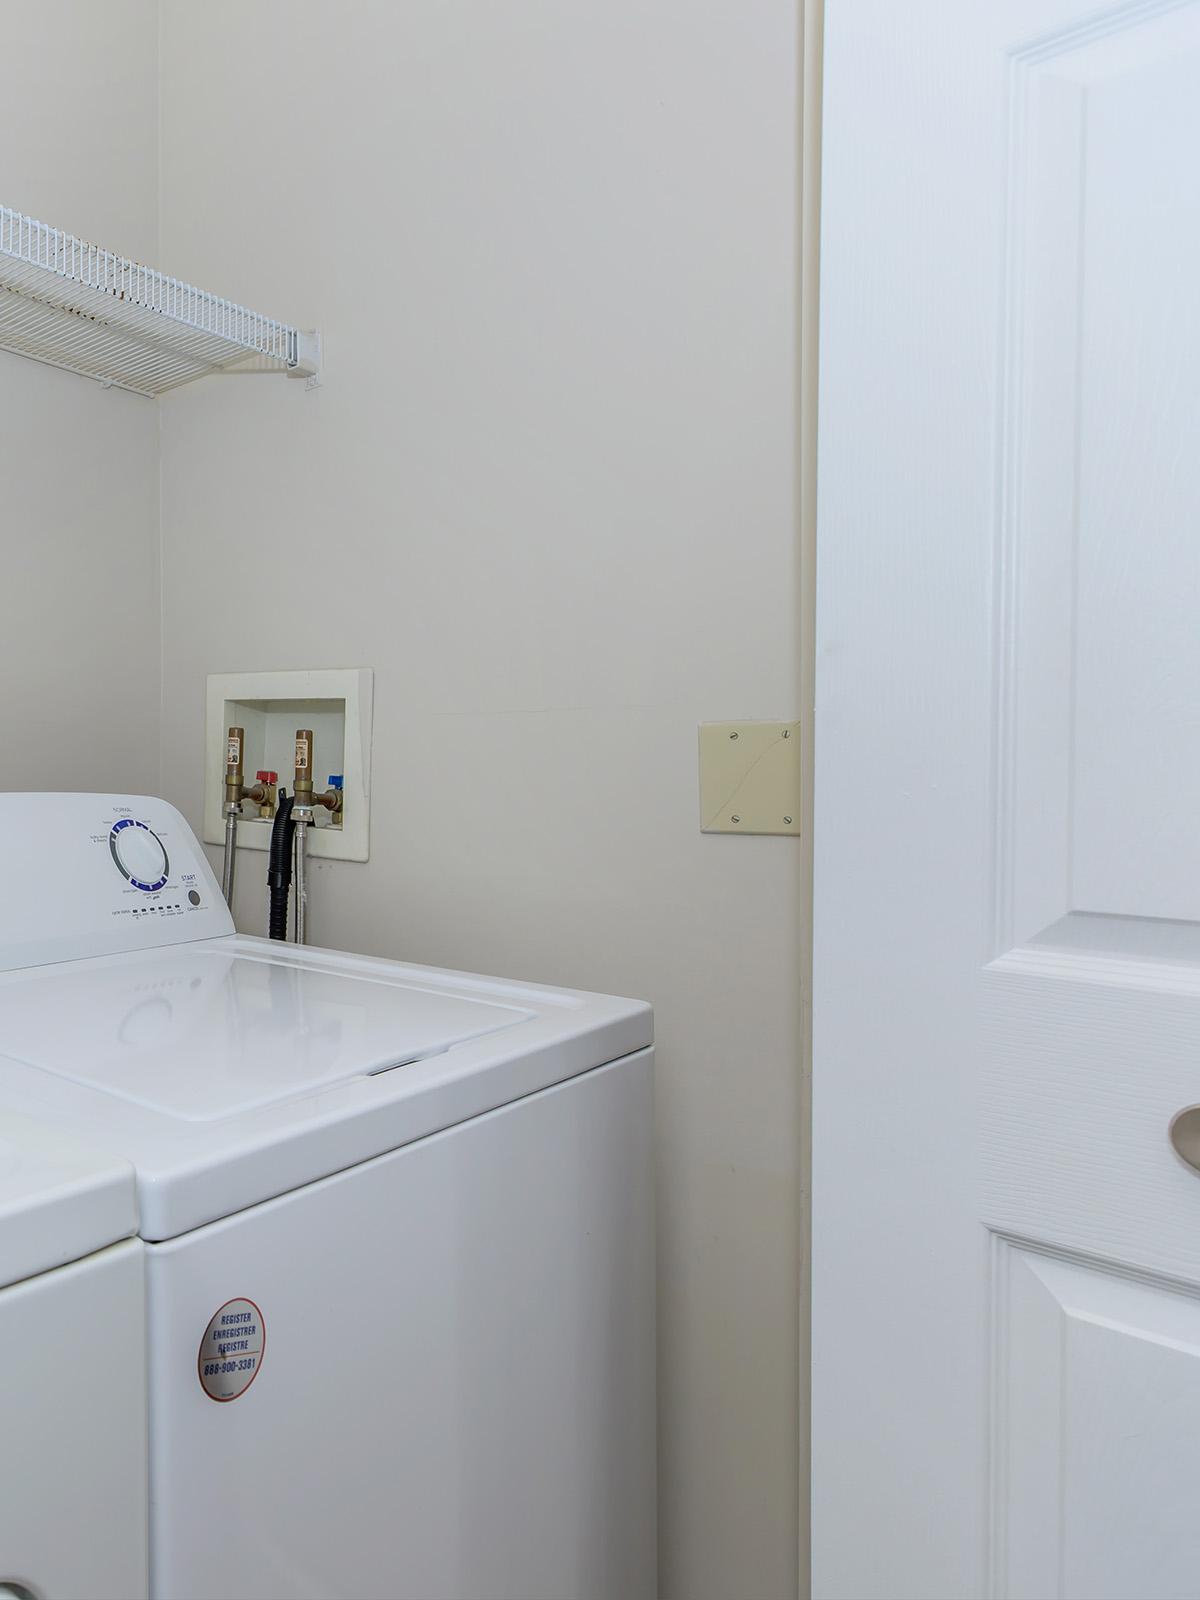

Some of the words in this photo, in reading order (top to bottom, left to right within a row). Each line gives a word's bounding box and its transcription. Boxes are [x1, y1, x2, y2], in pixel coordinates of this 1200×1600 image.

[221, 1312, 251, 1325] REGISTER
[213, 1325, 256, 1340] ENREGISTRER
[218, 1340, 248, 1353] REGISTRE
